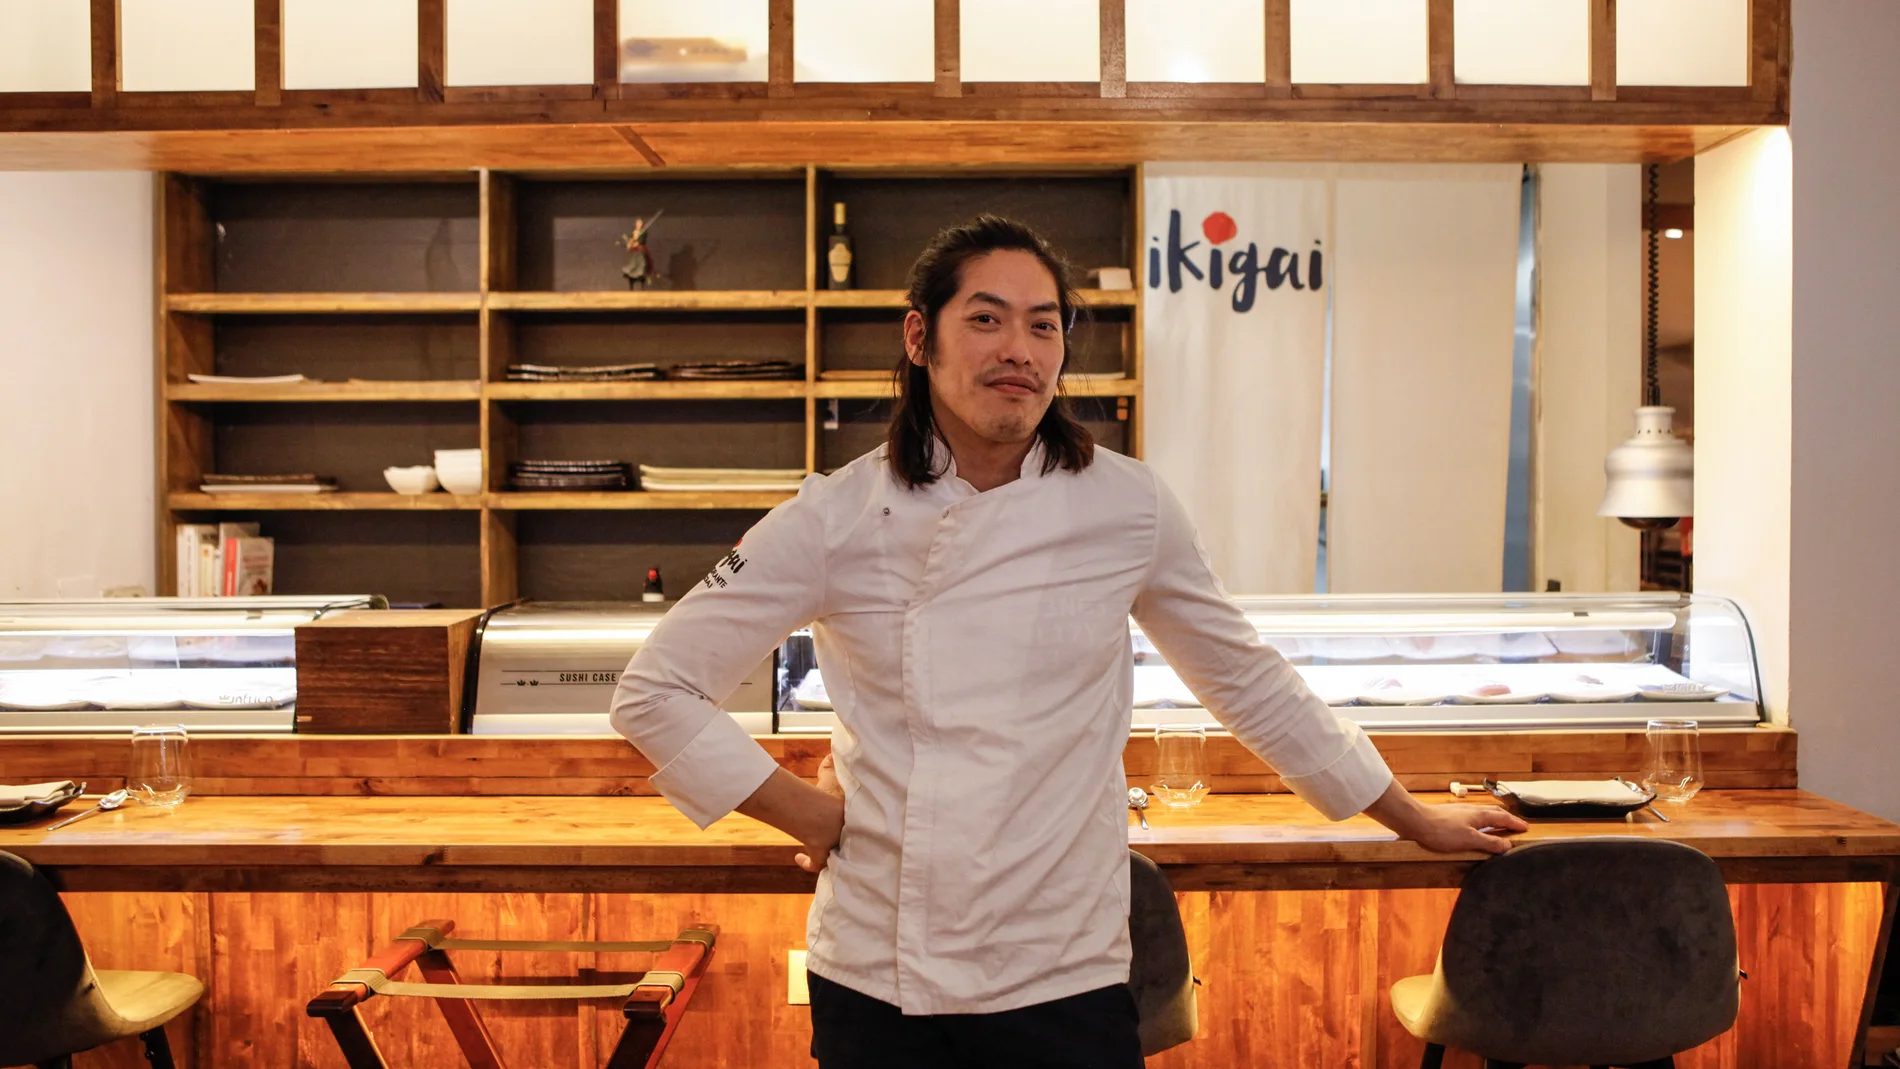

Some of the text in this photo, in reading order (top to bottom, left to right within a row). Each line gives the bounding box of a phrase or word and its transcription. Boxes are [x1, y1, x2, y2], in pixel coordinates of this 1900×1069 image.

[1149, 208, 1323, 313] ikigai
[718, 549, 748, 574] gai
[559, 672, 617, 683] SUSHI CASE
